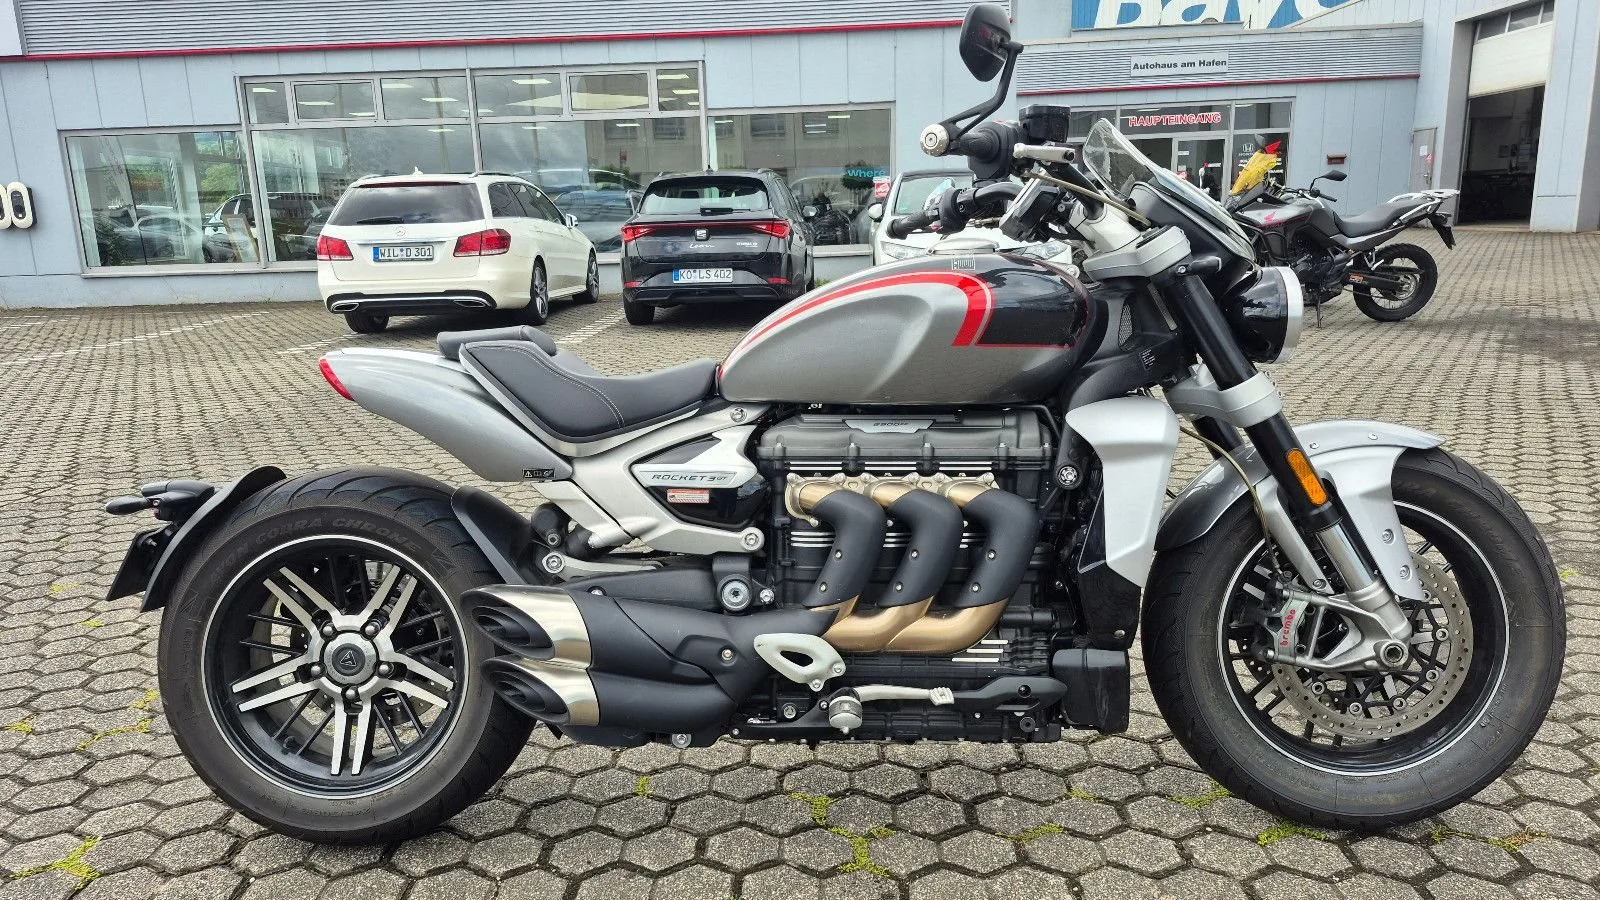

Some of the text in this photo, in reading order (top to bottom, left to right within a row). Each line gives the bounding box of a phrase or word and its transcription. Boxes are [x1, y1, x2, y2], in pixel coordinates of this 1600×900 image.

[1132, 59, 1227, 70] Autohaus am Hafen
[1128, 112, 1222, 127] HAUPTEINGANG
[379, 247, 433, 258] WIL D 301
[679, 269, 732, 280] KO LS 402
[256, 518, 323, 544] COBRA
[332, 518, 422, 551] CHROME
[1280, 609, 1295, 646] brembo
